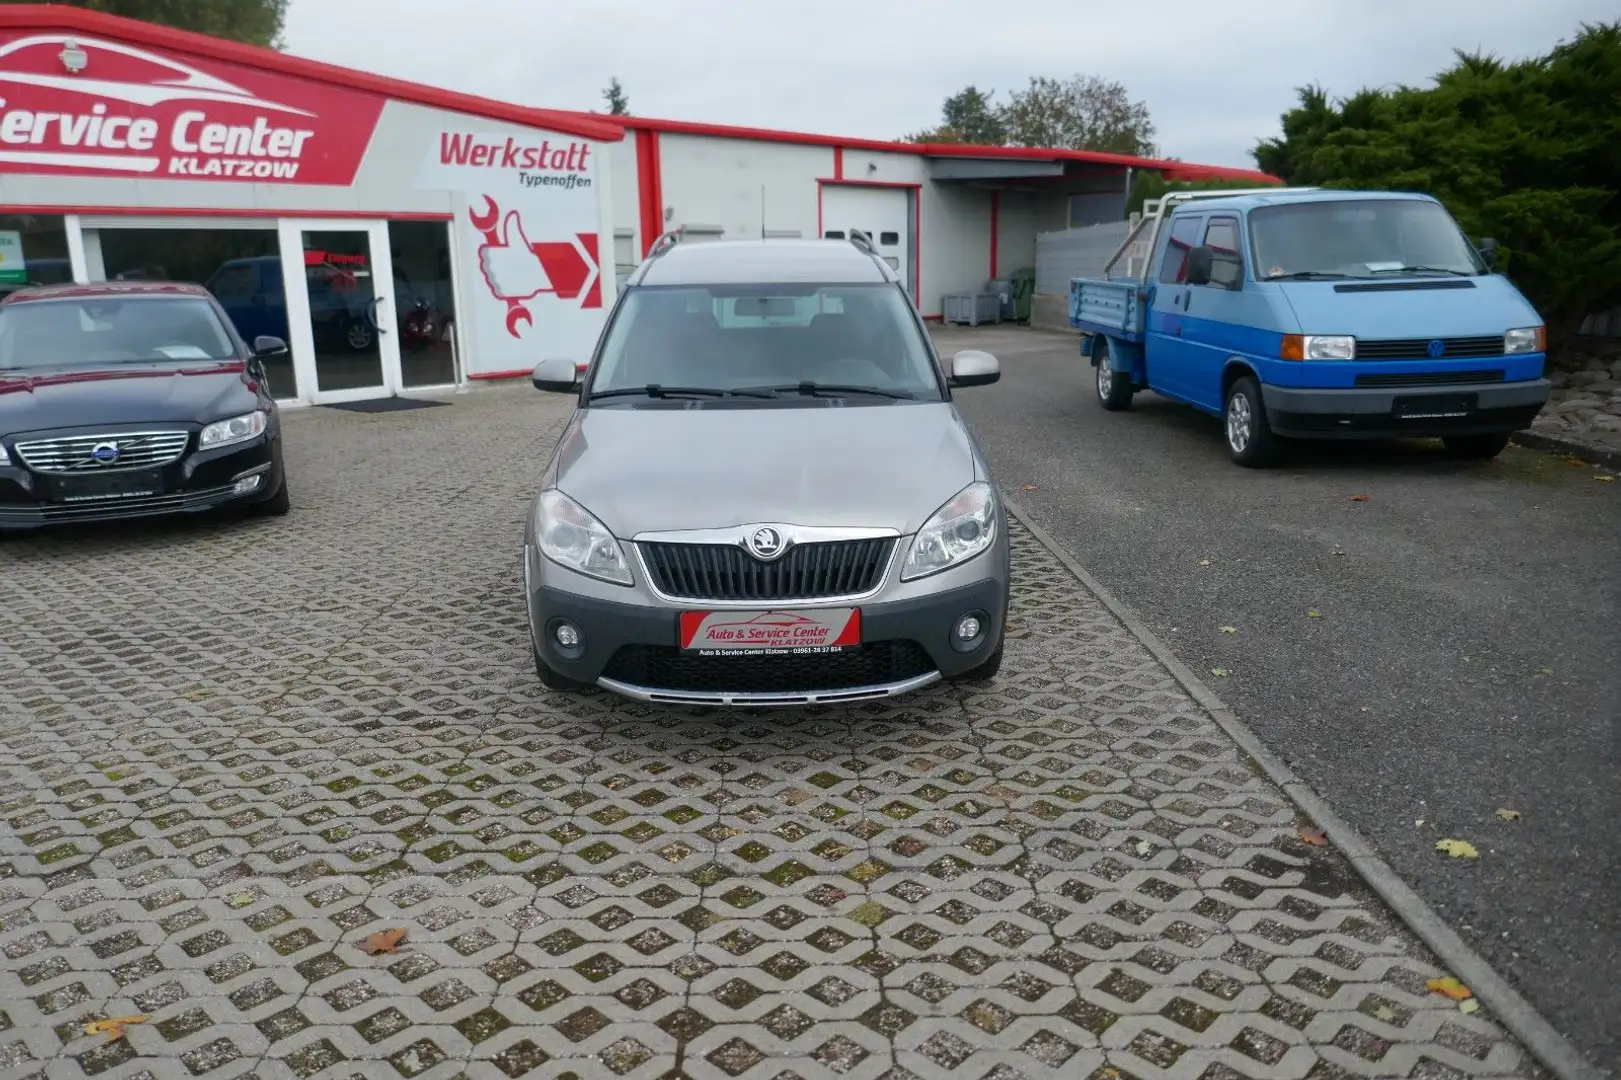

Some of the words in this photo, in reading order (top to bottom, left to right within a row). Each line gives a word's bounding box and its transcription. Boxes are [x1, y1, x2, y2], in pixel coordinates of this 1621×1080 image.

[0, 98, 158, 150] ervice
[171, 110, 314, 158] Center
[440, 132, 591, 171] Werkstatt
[168, 155, 299, 179] KLATZOW
[519, 172, 591, 189] Typenoffen
[707, 629, 734, 639] Auto
[735, 630, 745, 639] &
[747, 628, 790, 639] Service
[793, 626, 831, 637] Center
[770, 638, 826, 646] KLATZOW
[721, 648, 743, 656] Service
